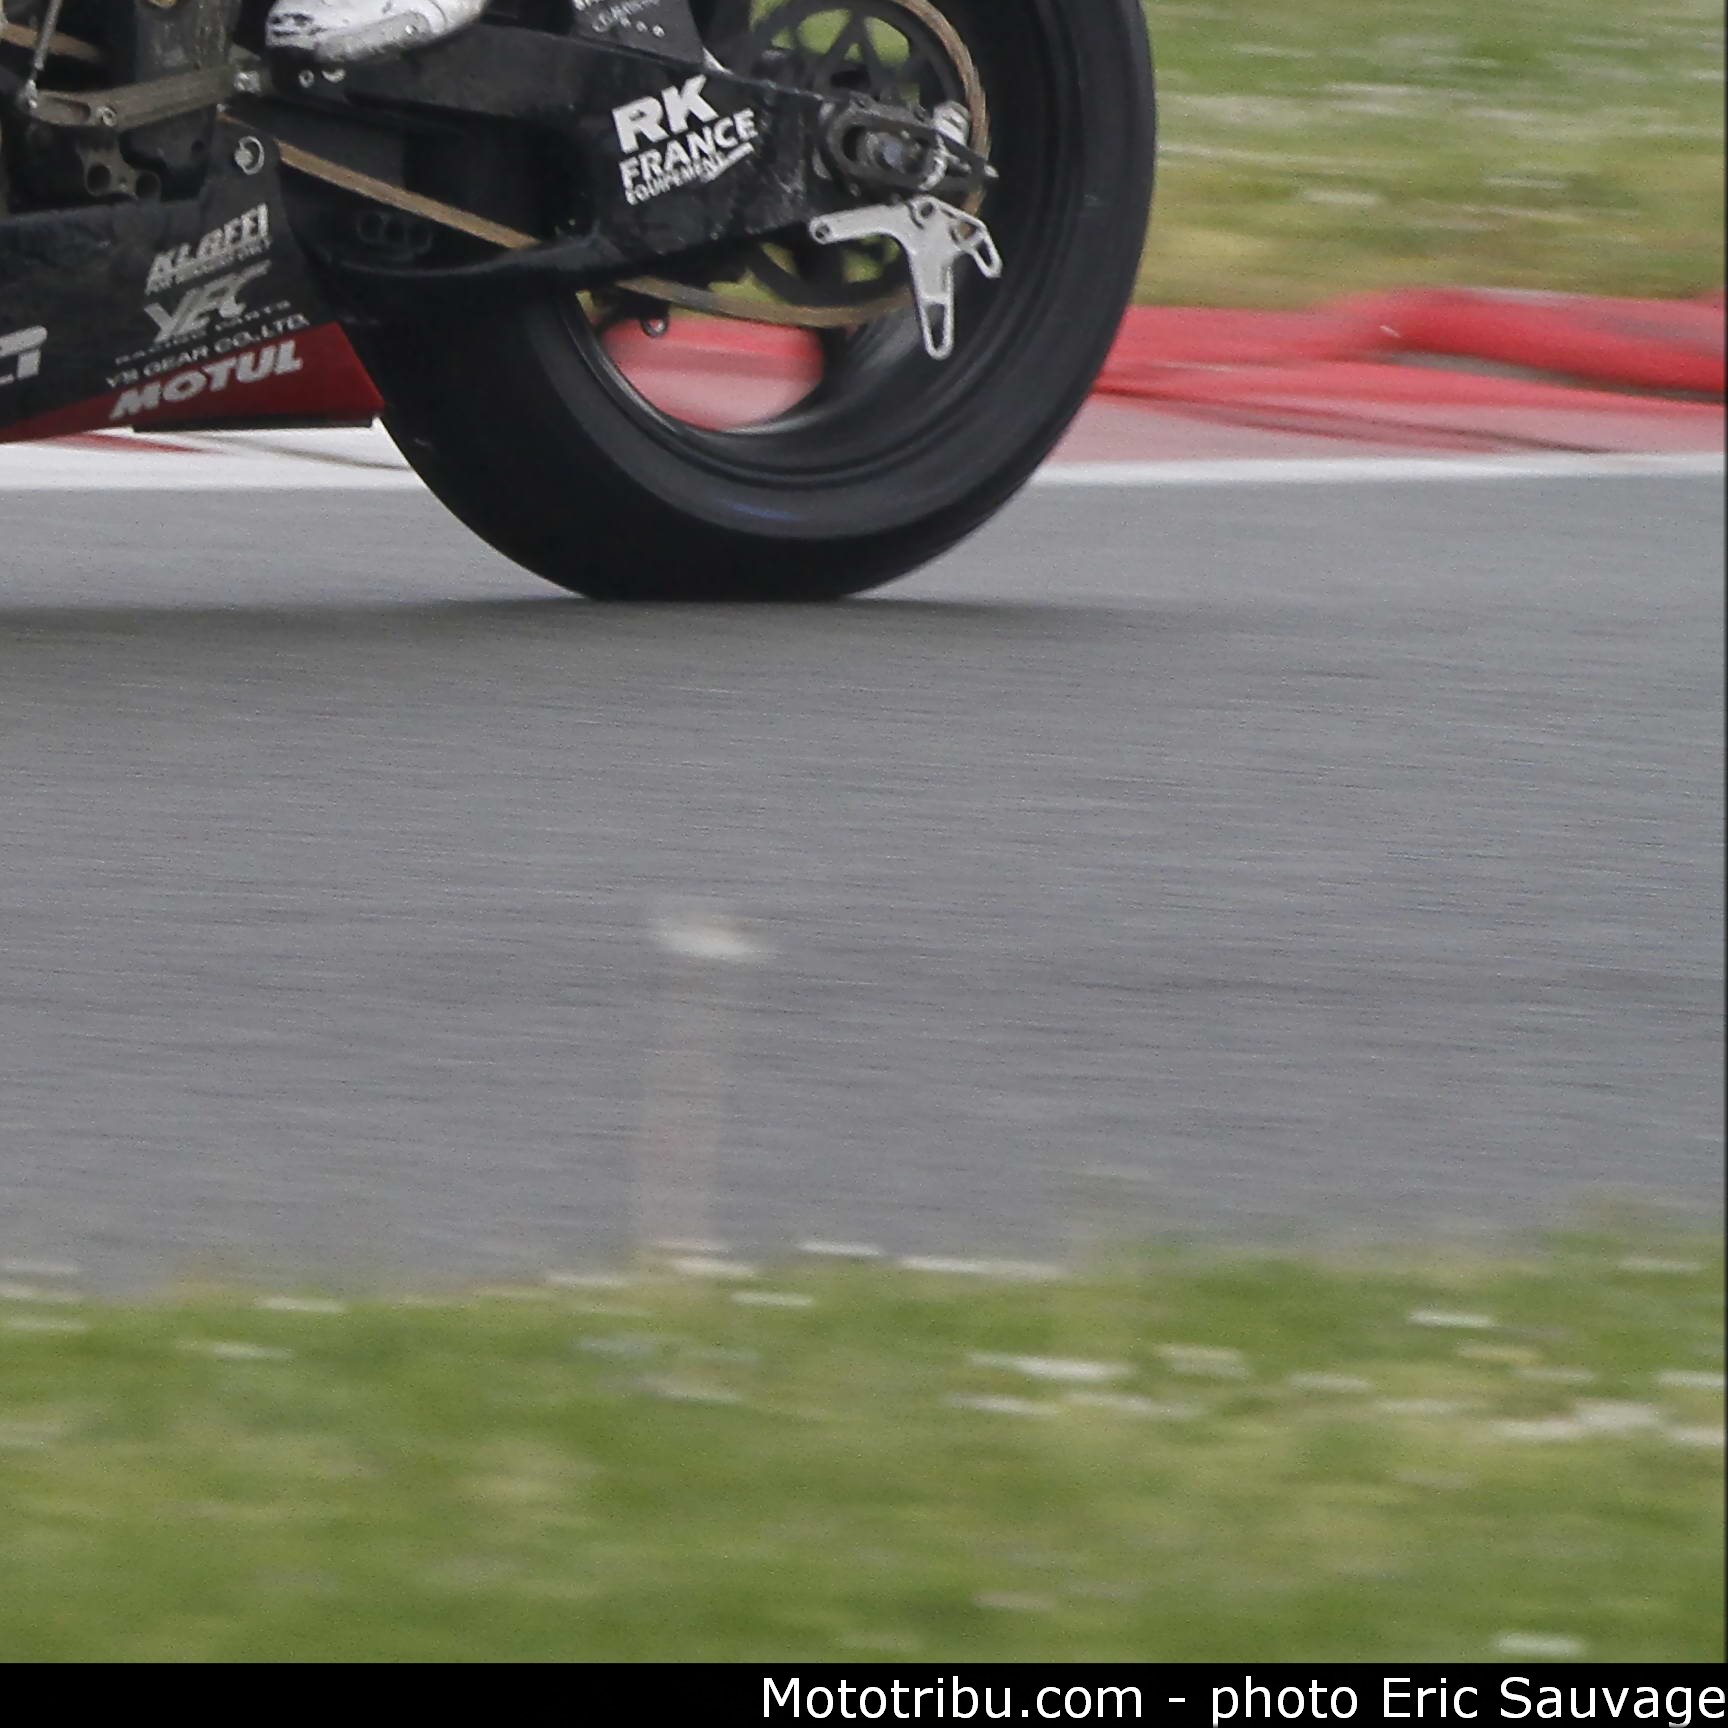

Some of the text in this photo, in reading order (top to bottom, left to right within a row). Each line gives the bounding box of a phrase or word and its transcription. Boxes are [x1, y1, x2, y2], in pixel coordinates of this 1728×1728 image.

[612, 74, 720, 155] RK
[618, 107, 759, 191] FRANCE
[108, 339, 305, 421] MOTUL
